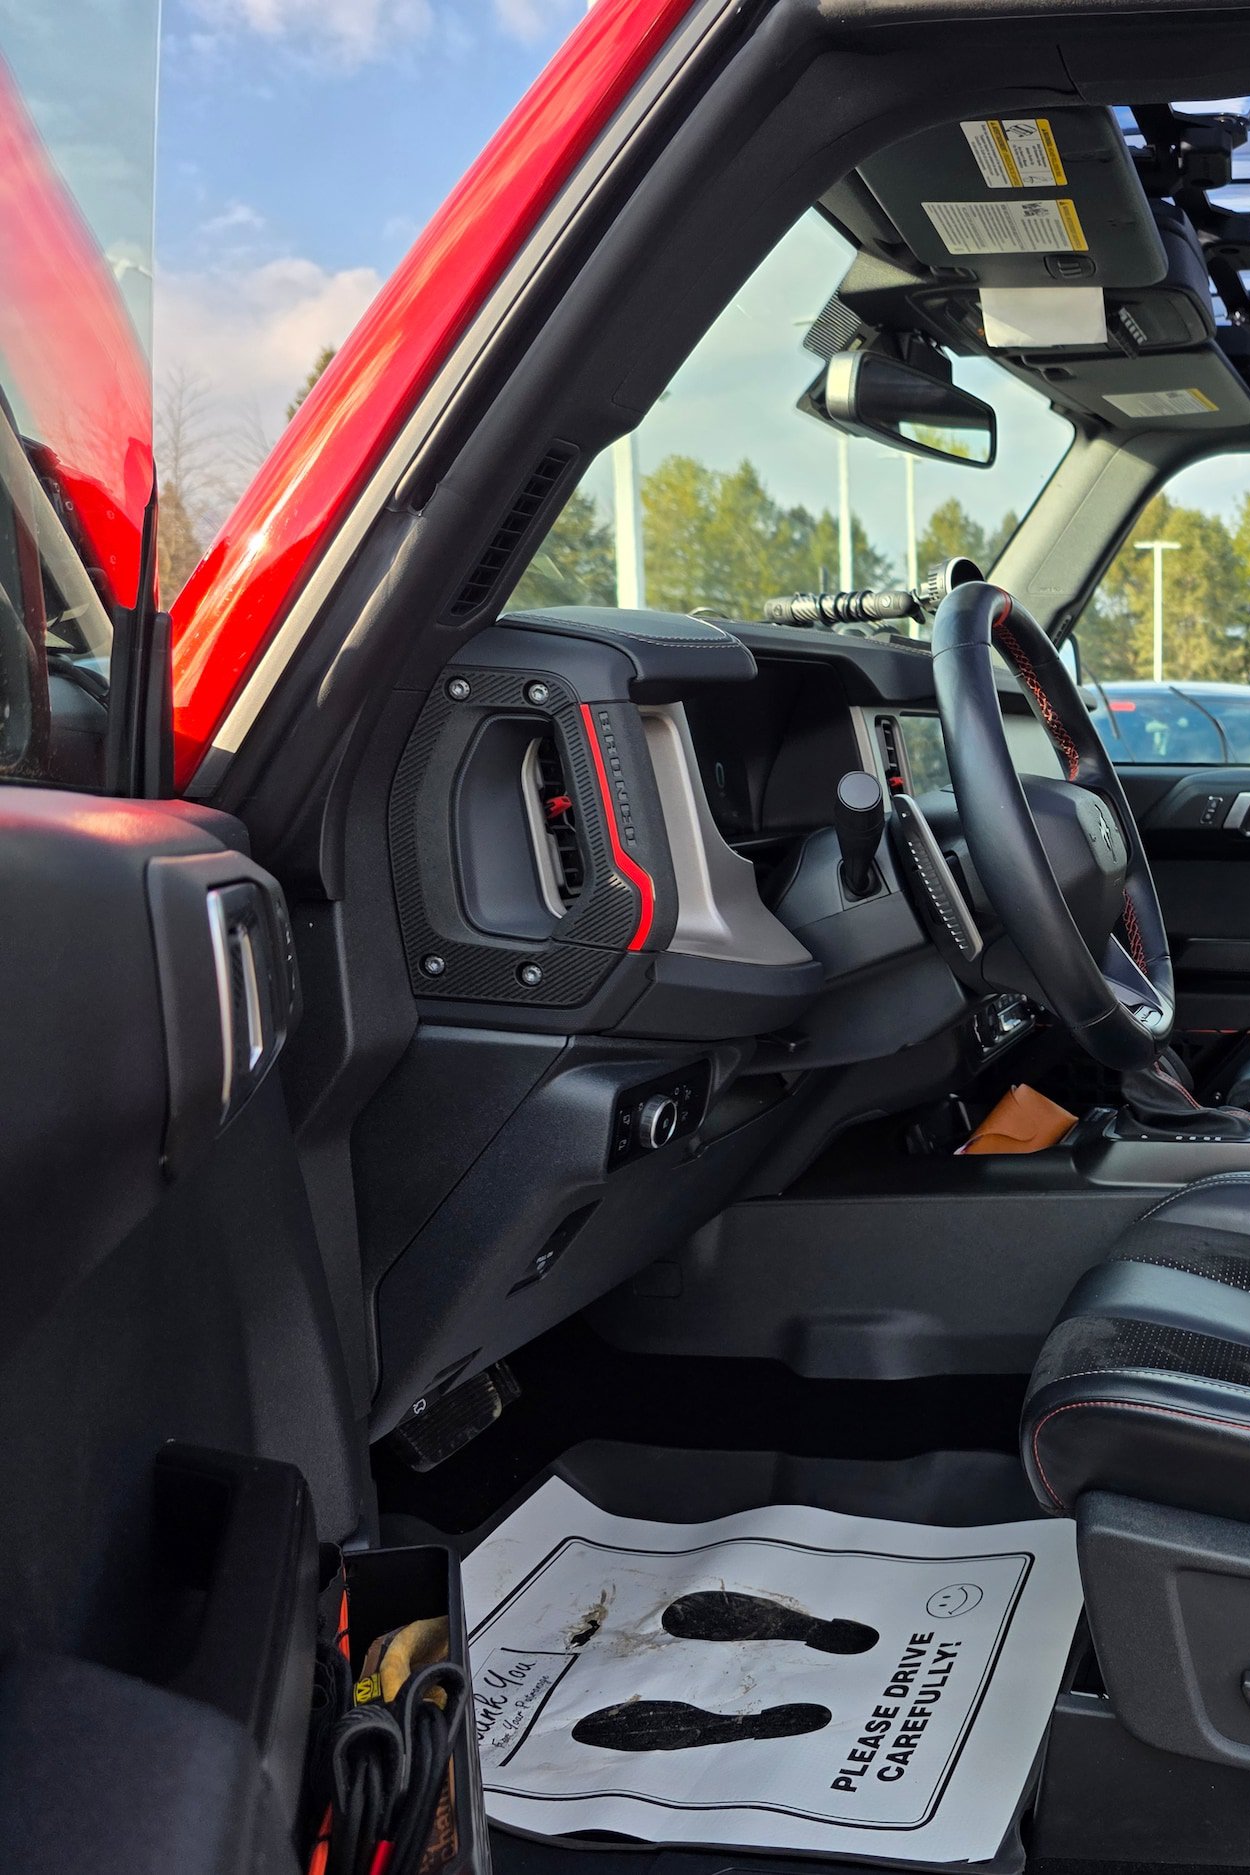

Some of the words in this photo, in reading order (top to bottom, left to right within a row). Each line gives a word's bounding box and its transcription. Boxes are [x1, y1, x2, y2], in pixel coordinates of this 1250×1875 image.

[598, 711, 637, 847] BRONCO
[483, 1662, 537, 1689] You
[830, 1704, 901, 1793] PLEASE
[882, 1632, 935, 1698] DRIVE
[876, 1641, 962, 1782] CAREFULLY!
